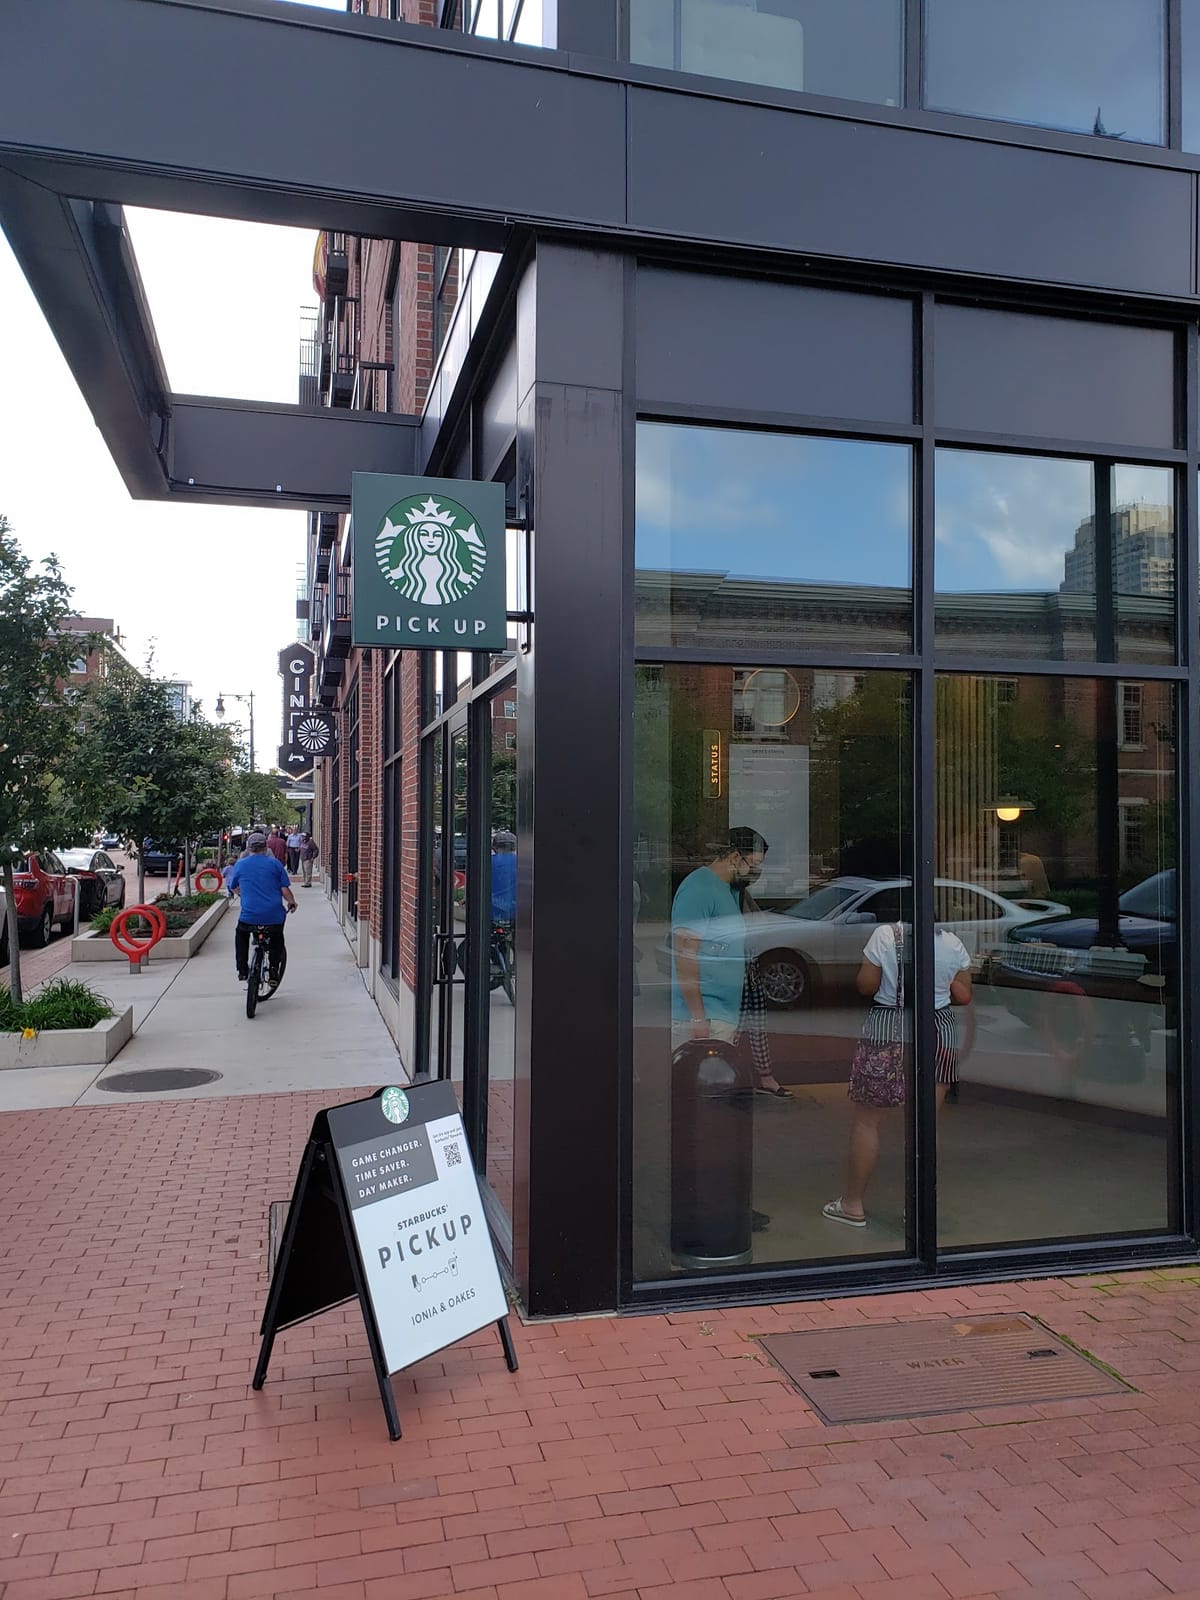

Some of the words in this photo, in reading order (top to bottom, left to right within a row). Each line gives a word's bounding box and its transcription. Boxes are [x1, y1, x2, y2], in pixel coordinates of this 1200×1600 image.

[376, 615, 440, 633] PICK
[454, 619, 487, 635] UP
[711, 744, 719, 784] STATUS
[351, 1152, 378, 1168] GAME
[379, 1140, 423, 1159] CHANGER.
[355, 1169, 378, 1183] TIME
[379, 1160, 410, 1175] SAVER.
[359, 1185, 376, 1199] DAY
[379, 1175, 413, 1192] MAKER.
[378, 1214, 472, 1270] PICKUP
[411, 1306, 439, 1326] IONIA
[440, 1302, 447, 1313] &
[448, 1288, 476, 1308] OAKES
[905, 1358, 966, 1369] WATER
